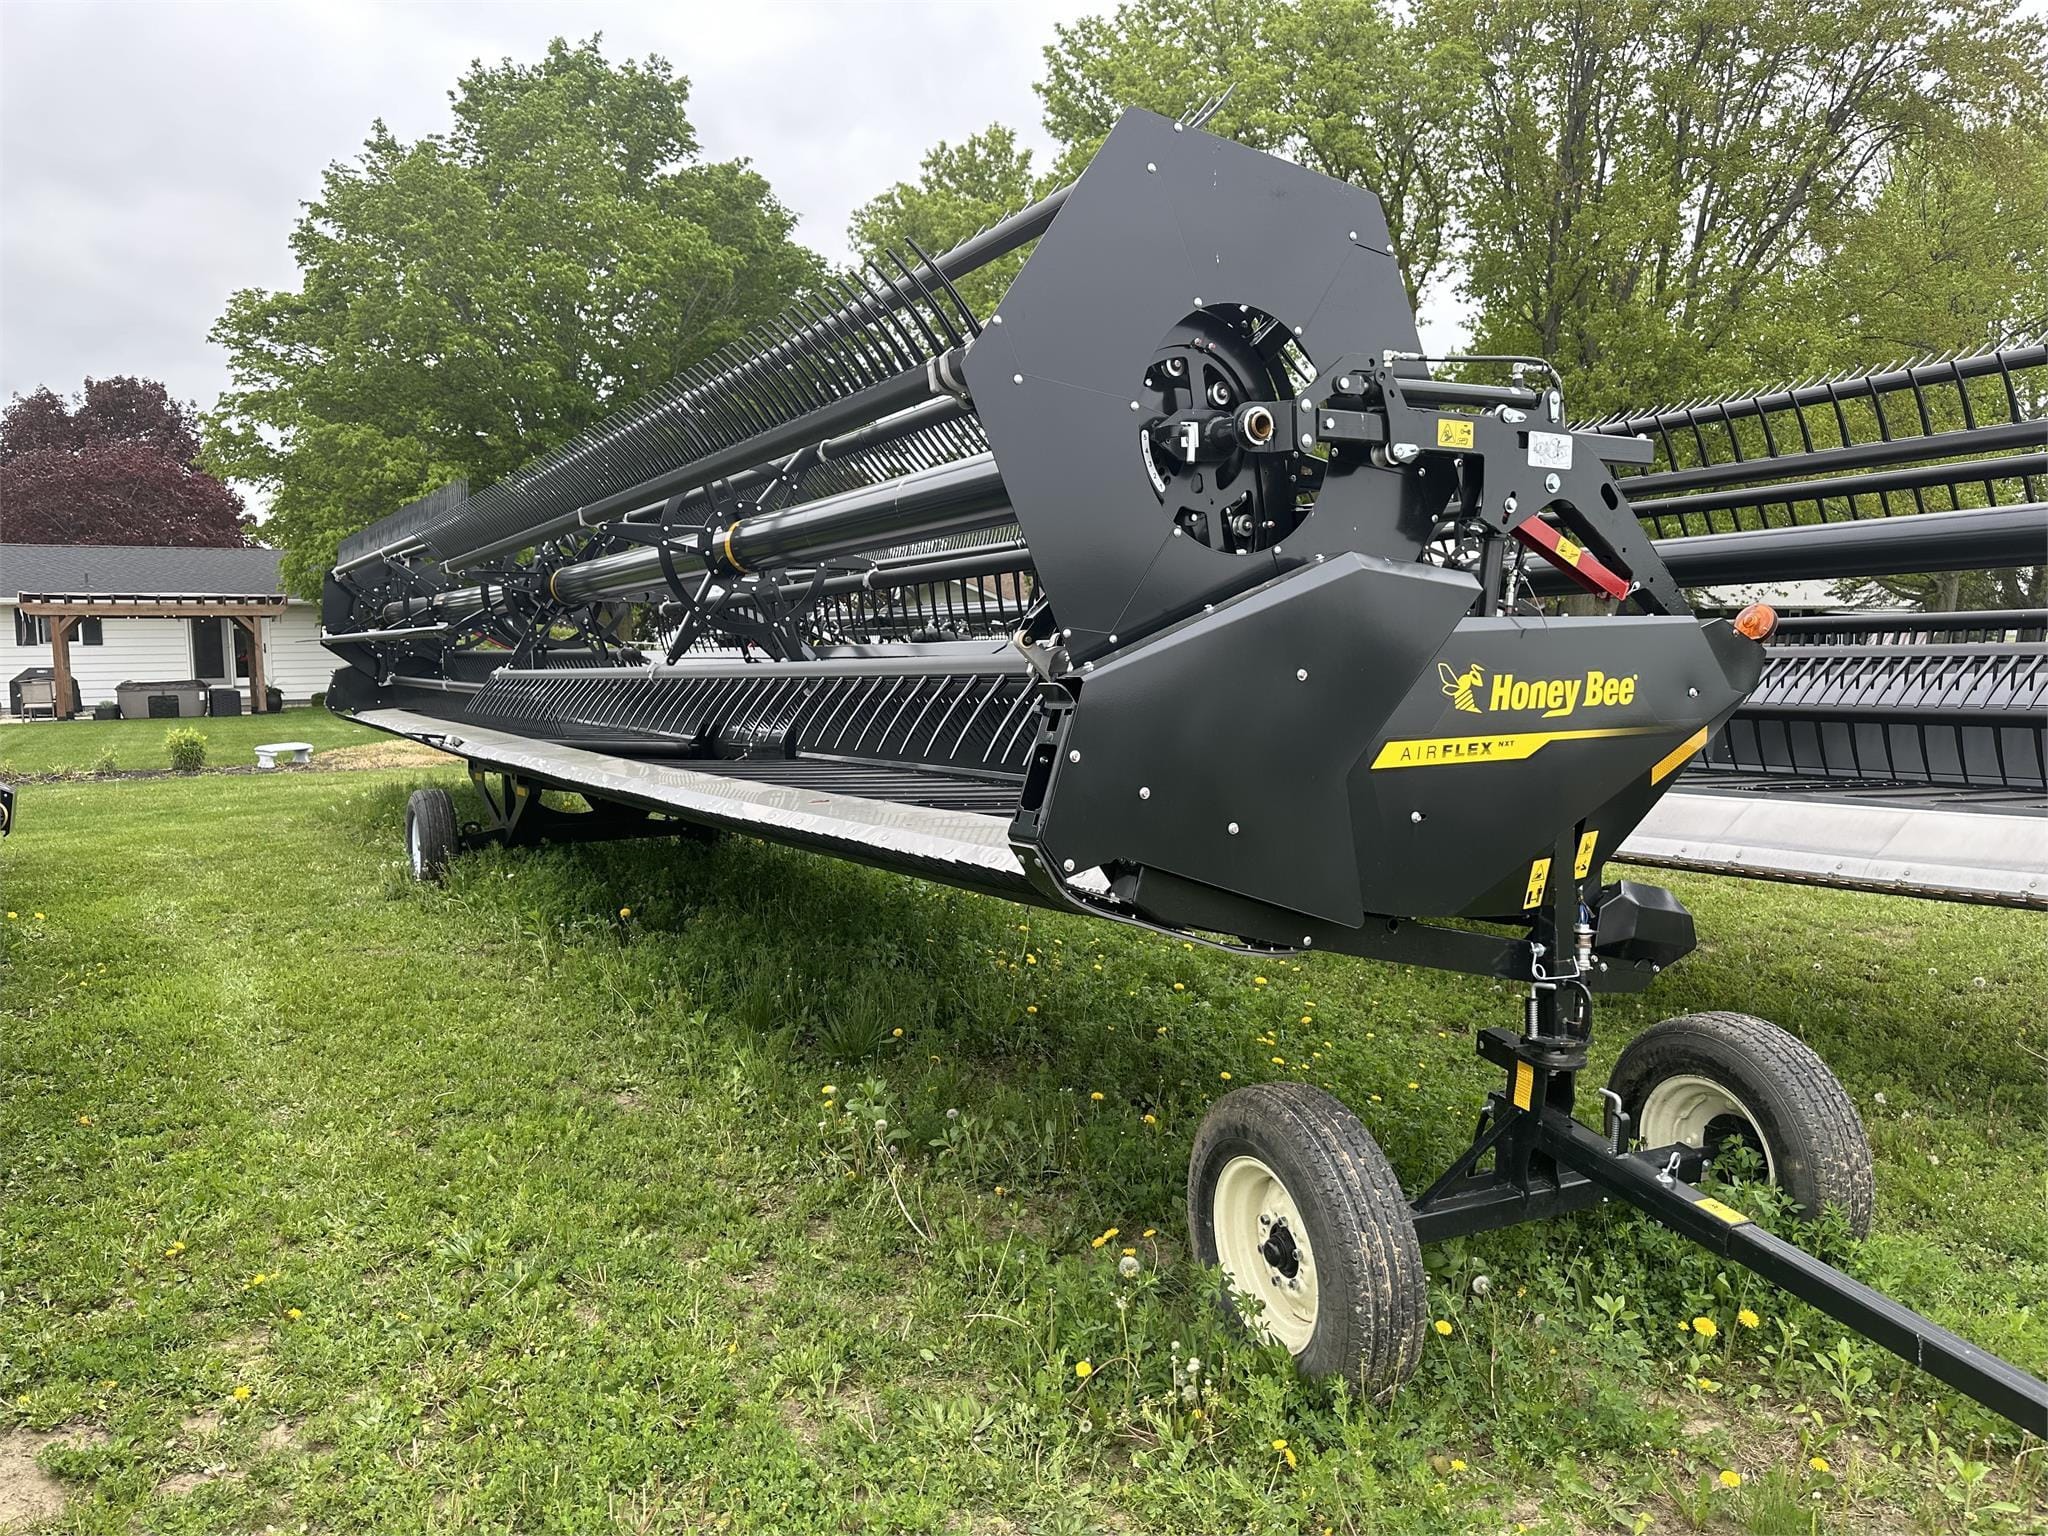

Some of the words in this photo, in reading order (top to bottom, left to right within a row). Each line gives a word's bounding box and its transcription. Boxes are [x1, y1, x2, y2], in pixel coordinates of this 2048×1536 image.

[1489, 673, 1582, 718] Honey
[1582, 671, 1635, 706] Bee
[1400, 742, 1494, 761] AIRFLEX
[1498, 740, 1515, 748] NXT
